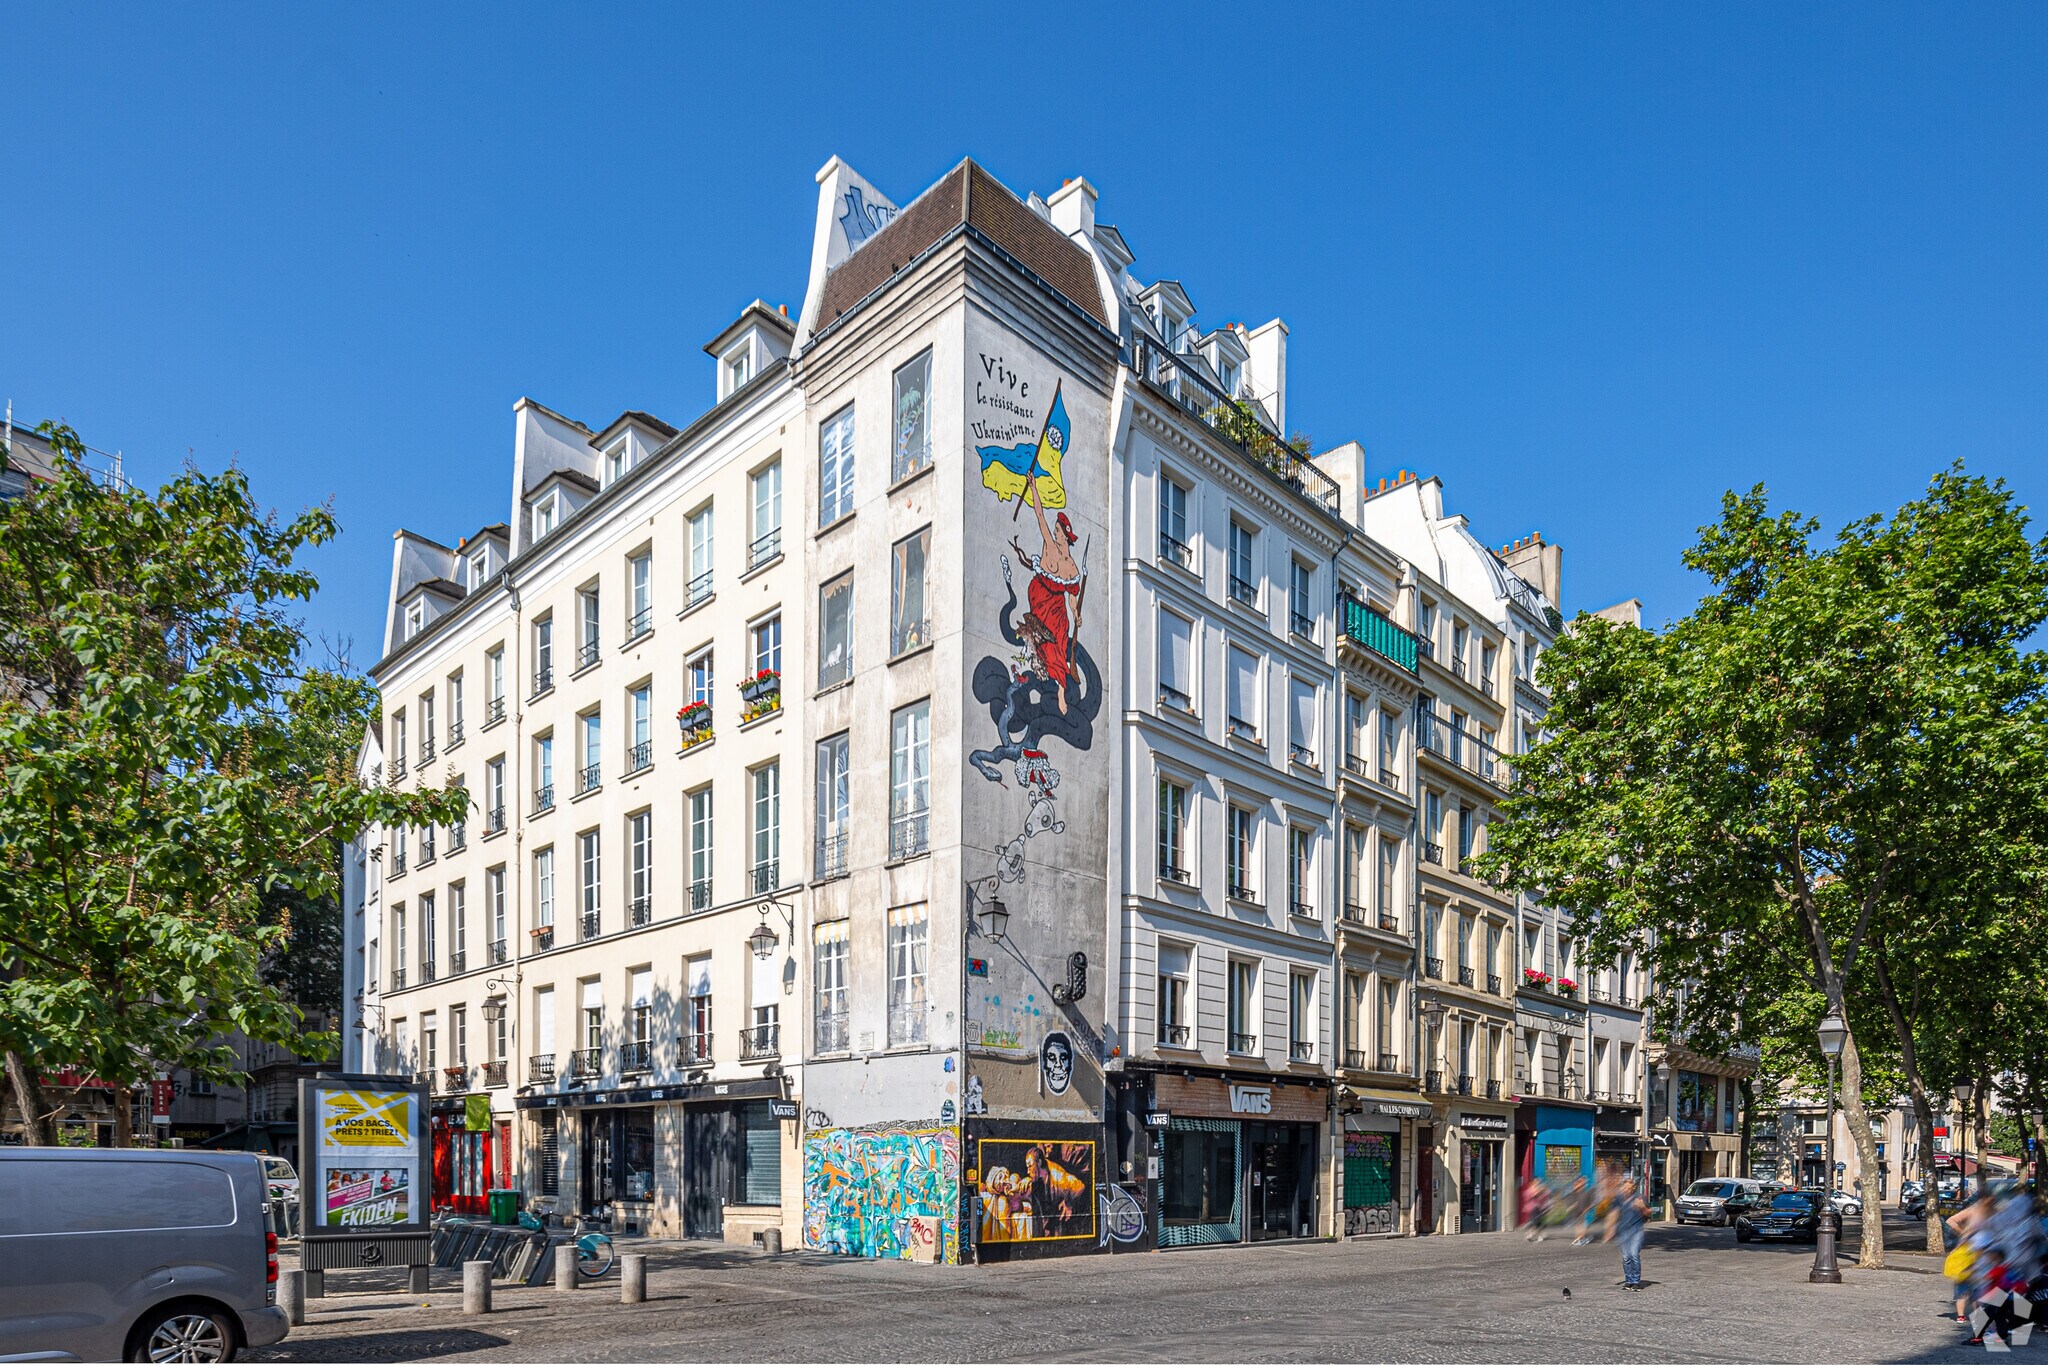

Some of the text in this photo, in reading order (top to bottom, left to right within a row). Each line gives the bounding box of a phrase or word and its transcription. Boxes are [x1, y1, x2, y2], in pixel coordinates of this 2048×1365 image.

[979, 353, 1028, 398] Vive
[976, 381, 1034, 418] La résistance
[971, 419, 1035, 441] Ukrainienne
[771, 1104, 796, 1116] VANS
[1228, 1085, 1272, 1115] VANS
[1146, 1114, 1168, 1125] VANS
[340, 1197, 398, 1226] EKIDEN
[911, 1217, 934, 1245] BMC
